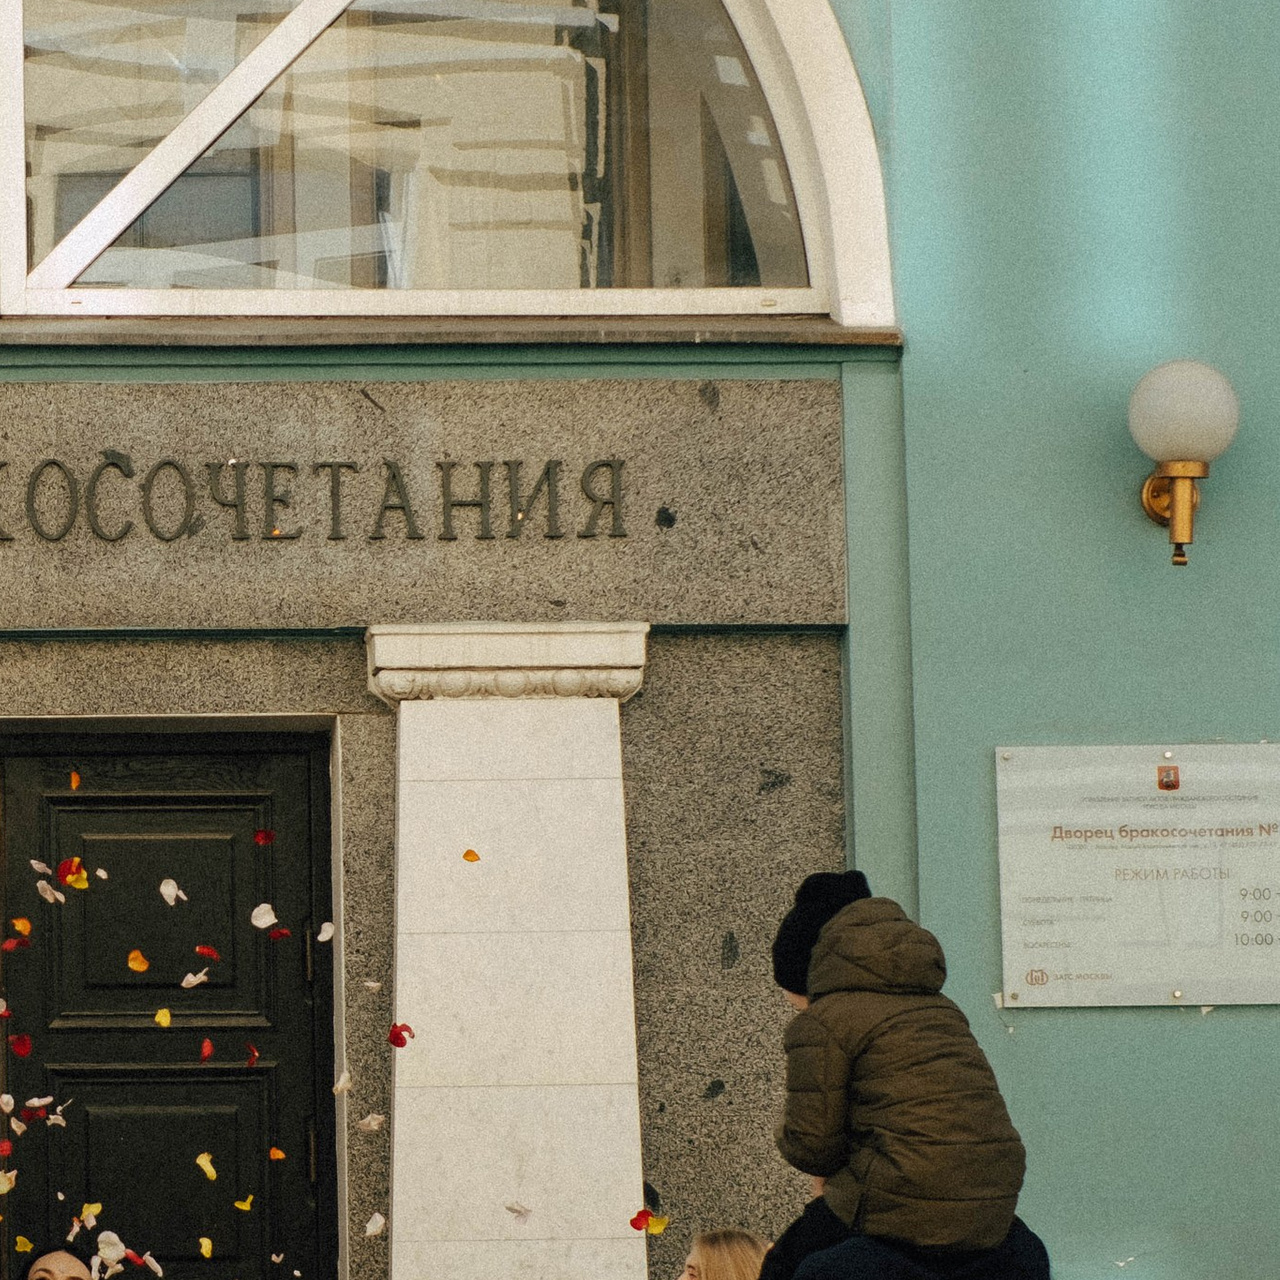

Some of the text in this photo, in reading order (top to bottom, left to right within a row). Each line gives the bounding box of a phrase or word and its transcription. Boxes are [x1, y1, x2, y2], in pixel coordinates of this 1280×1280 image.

[1051, 825, 1115, 842] Дворец
[1118, 824, 1254, 842] бракосочетания
[1114, 867, 1230, 881] РЕЖИМ РАБОТЫ
[1240, 887, 1272, 901] 9:00
[1235, 932, 1274, 946] 10:00
